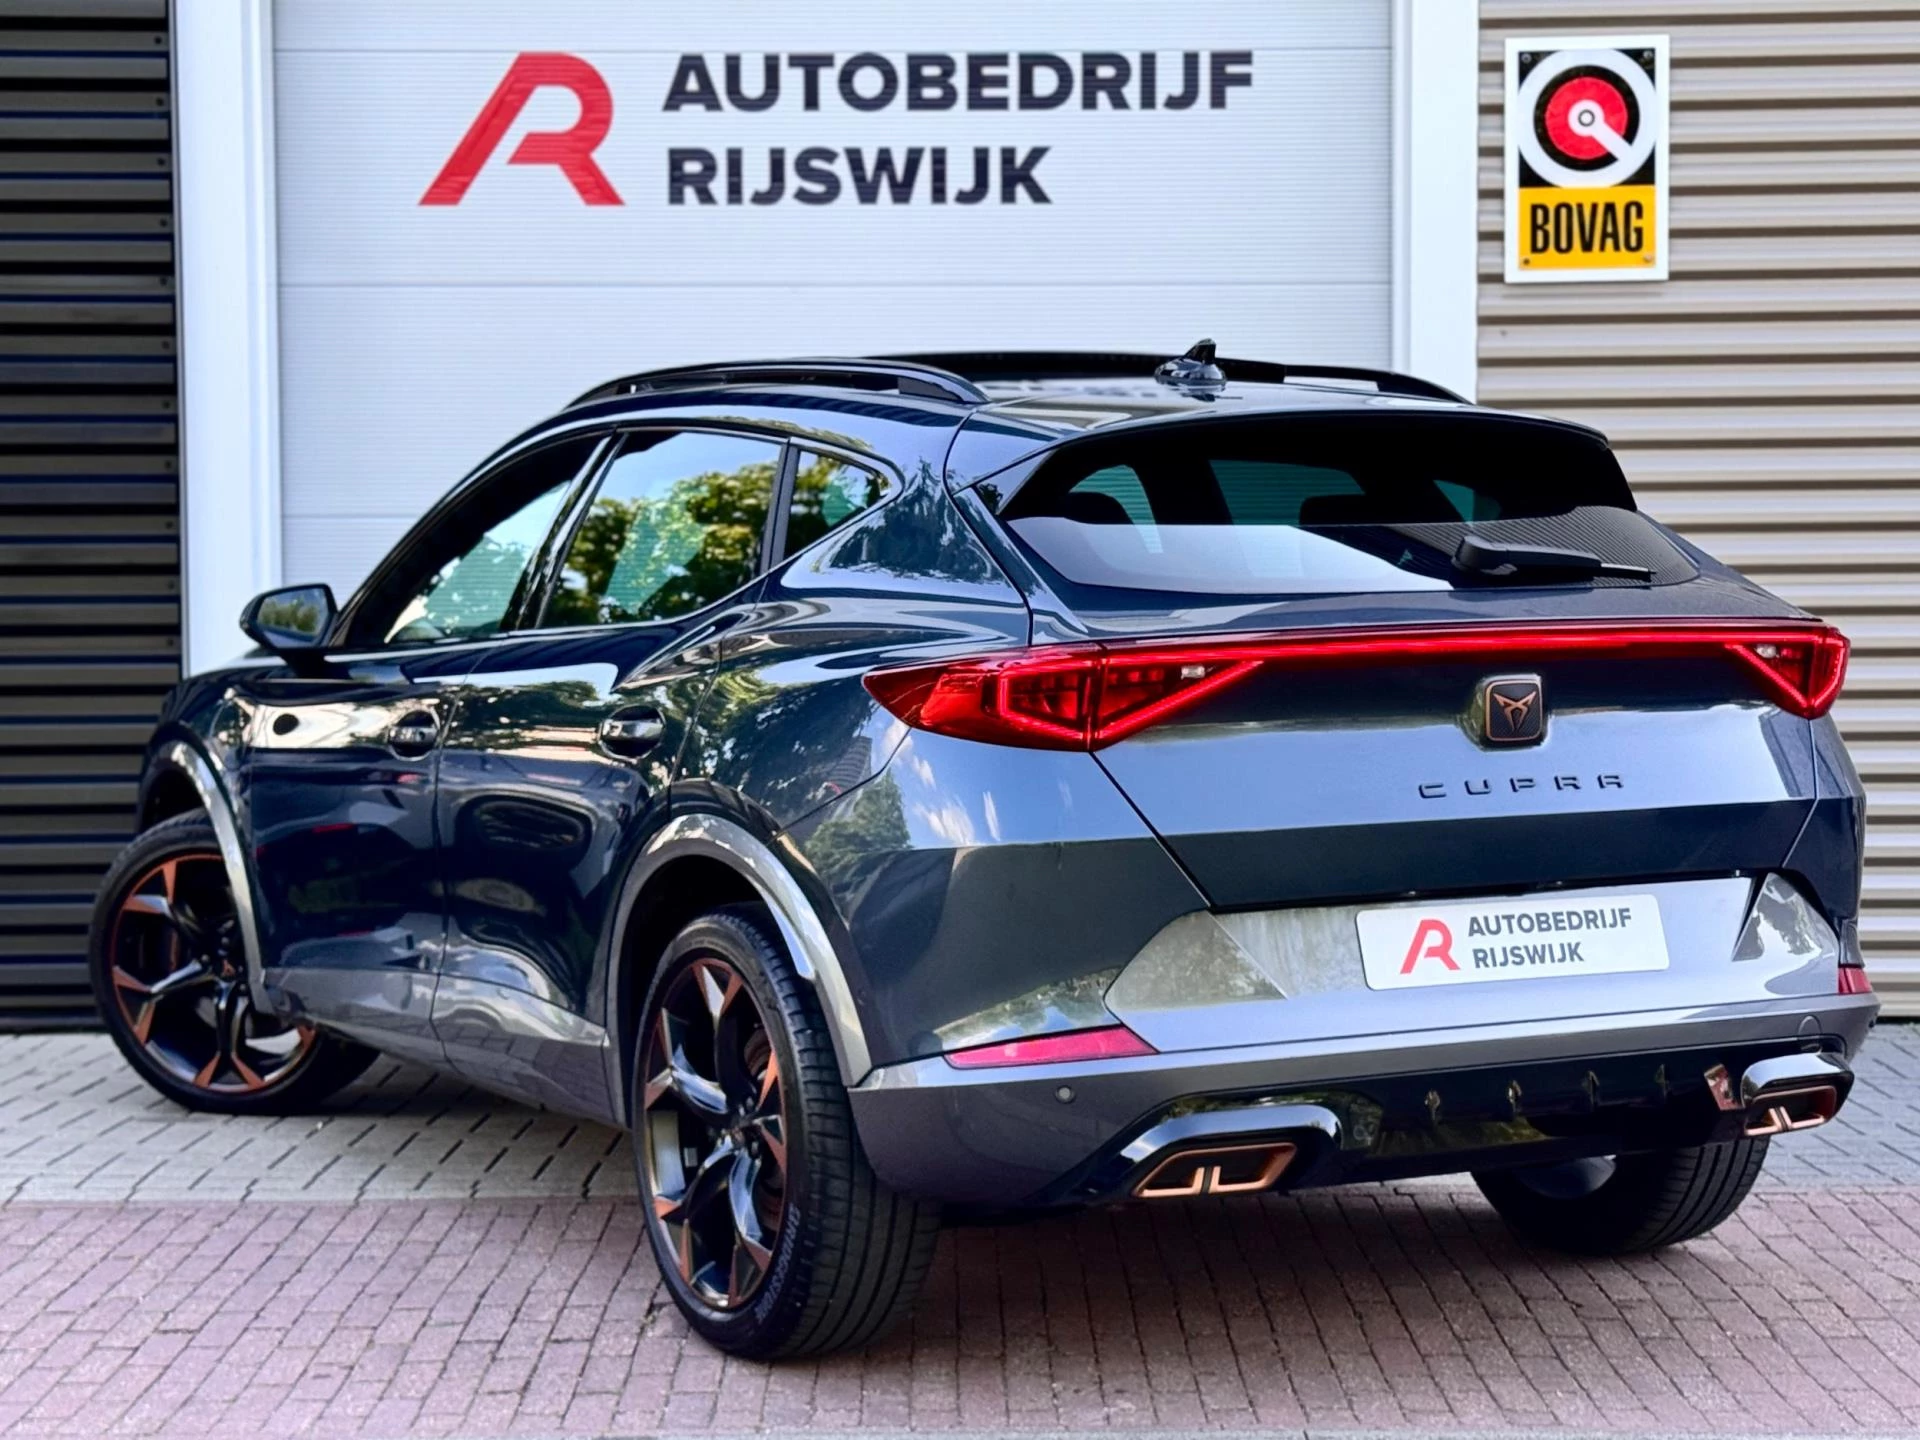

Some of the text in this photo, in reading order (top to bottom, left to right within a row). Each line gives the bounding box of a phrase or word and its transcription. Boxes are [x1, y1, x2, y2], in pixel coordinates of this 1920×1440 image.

[662, 51, 1253, 112] AUTOBEDRIJF
[667, 146, 1052, 206] RIJSWIJK
[1529, 200, 1644, 255] BOVAG
[1417, 773, 1624, 799] CUPRA
[1467, 907, 1632, 937] AUTOBEDRIJF
[1472, 941, 1584, 969] RIJSWIJK
